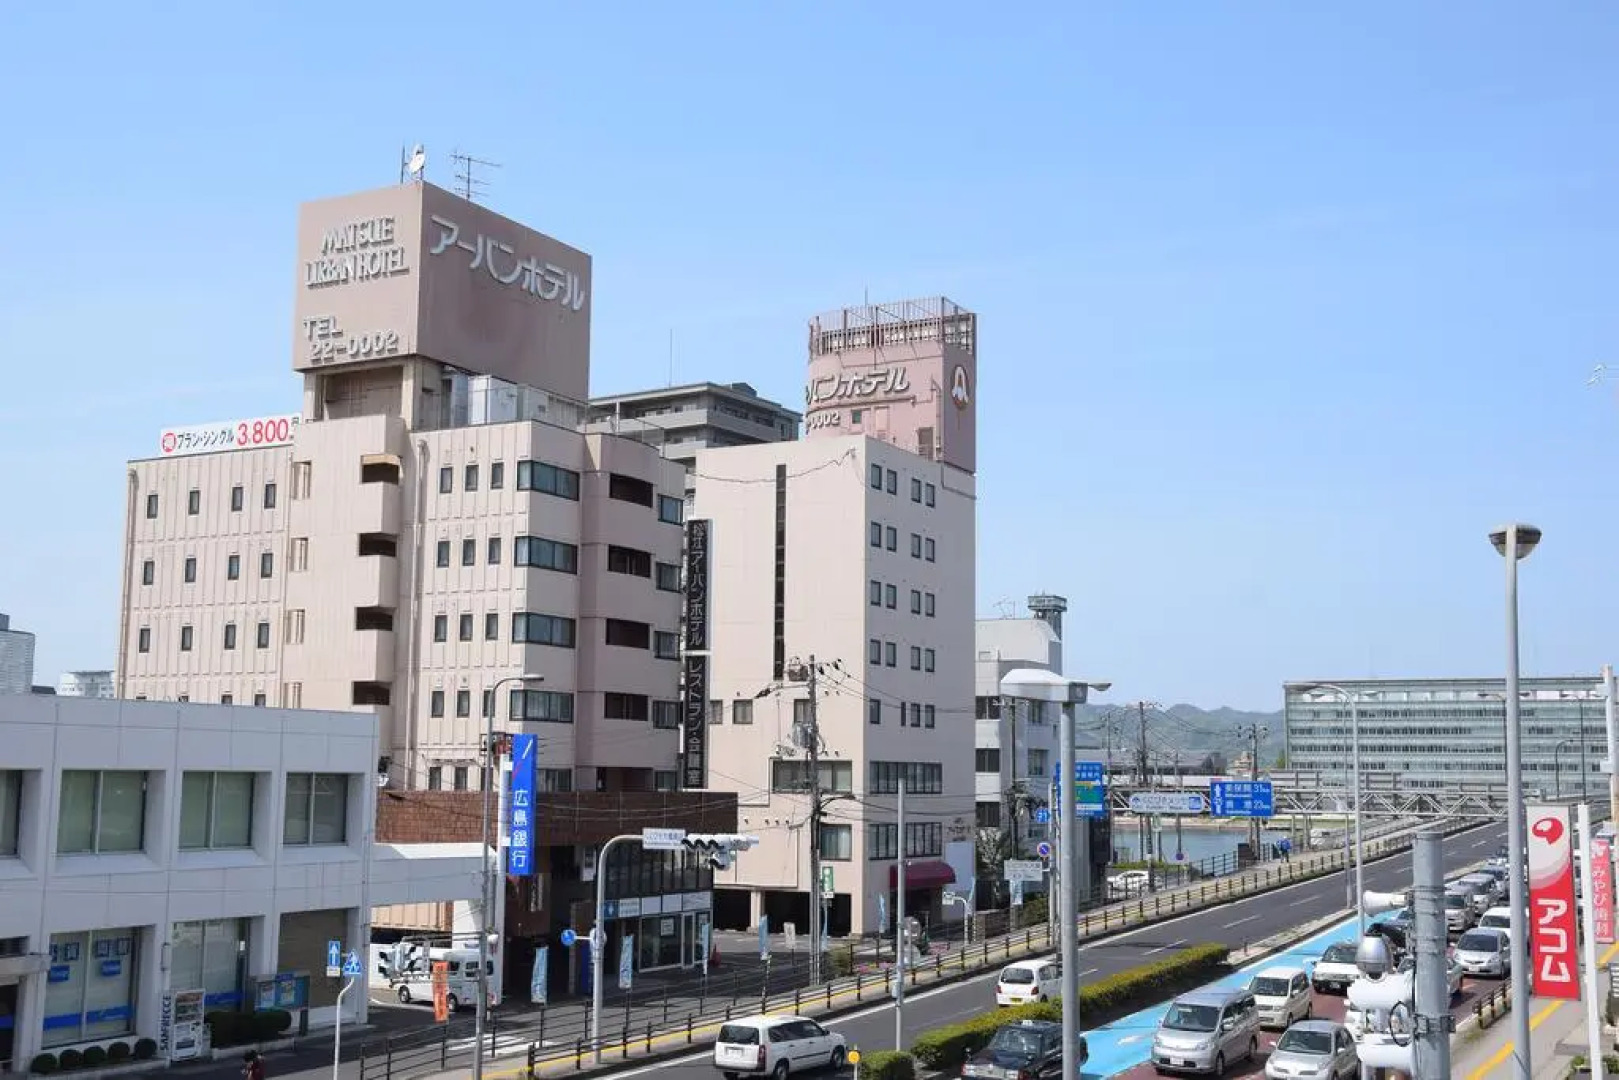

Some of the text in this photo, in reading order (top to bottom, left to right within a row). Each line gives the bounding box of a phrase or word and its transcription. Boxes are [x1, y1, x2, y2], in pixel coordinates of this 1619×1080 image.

[322, 216, 396, 256] MATSUE
[430, 213, 585, 312] アーバンホテル
[305, 246, 410, 290] URBAN HOTEL
[303, 315, 344, 342] TEL
[310, 328, 399, 365] 22-0002
[690, 521, 705, 647] 松江アーバンホテル
[512, 788, 529, 868] 広島銀行
[1536, 897, 1571, 983] アコム
